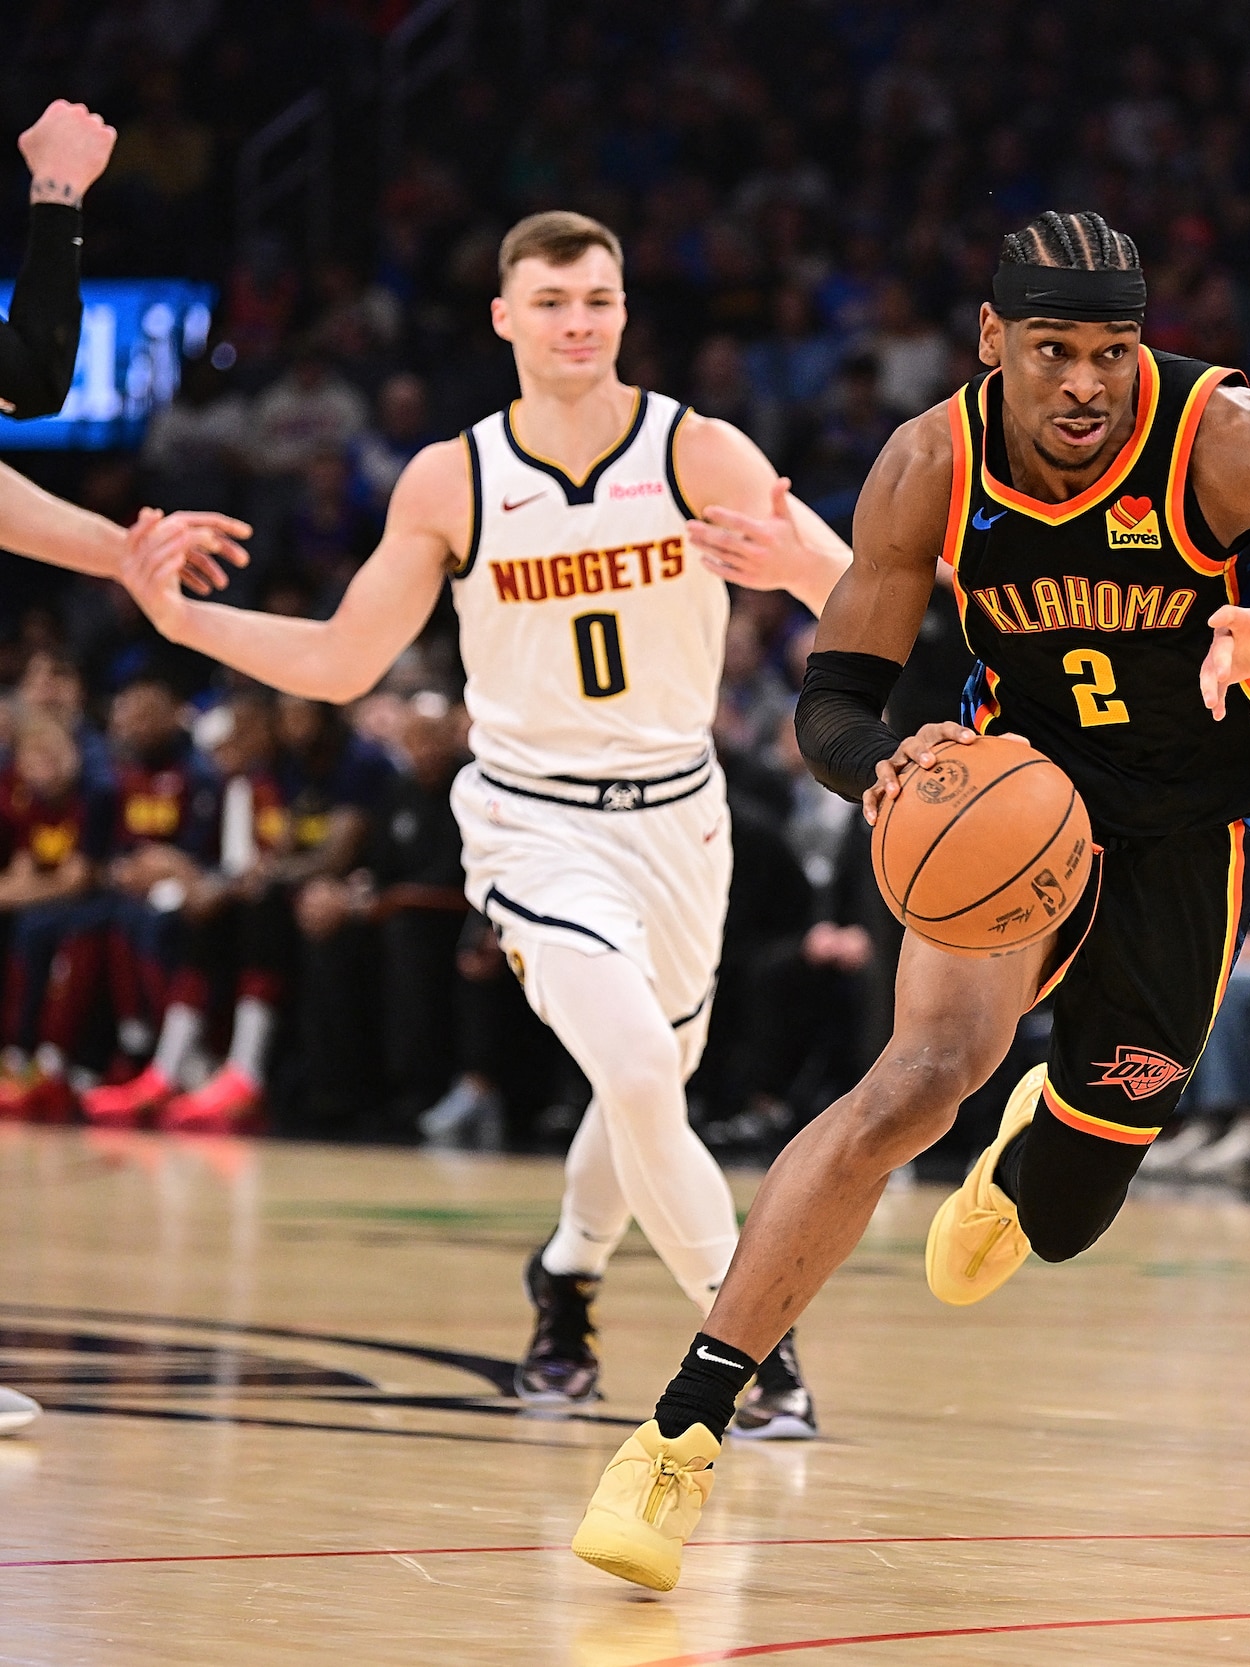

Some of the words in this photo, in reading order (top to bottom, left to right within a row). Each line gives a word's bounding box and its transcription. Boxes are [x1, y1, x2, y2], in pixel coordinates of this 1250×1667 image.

[489, 536, 685, 604] NUGGETS
[972, 575, 1197, 634] KLAHOMA
[571, 610, 630, 703] 0
[1062, 648, 1130, 728] 2
[1105, 1060, 1167, 1078] OKC
